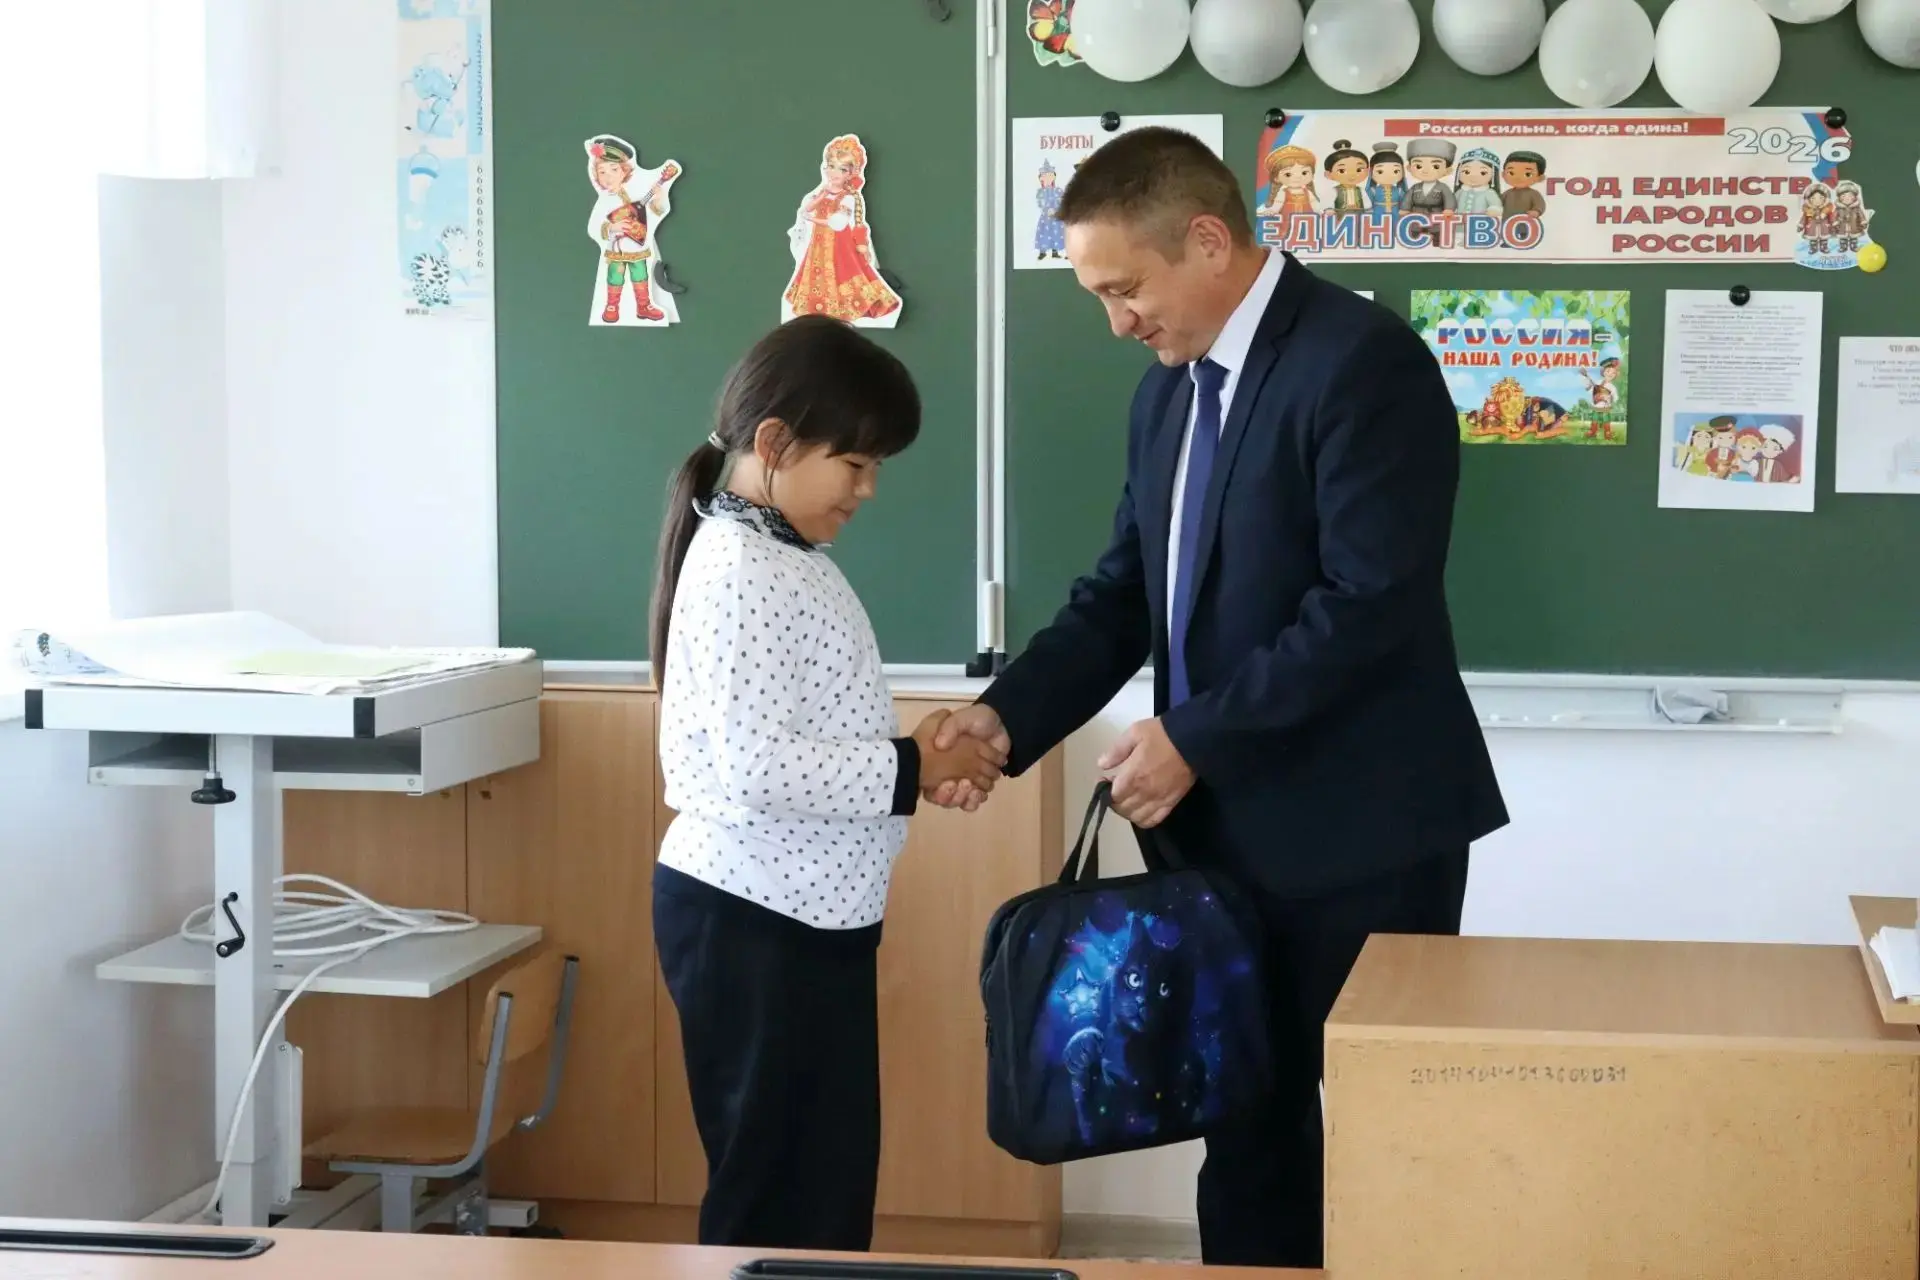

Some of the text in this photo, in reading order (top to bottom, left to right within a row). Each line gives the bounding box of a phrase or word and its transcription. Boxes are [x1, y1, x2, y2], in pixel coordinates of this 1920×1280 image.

[1419, 121, 1689, 135] Россия сильна, когда едина!
[1040, 135, 1094, 149] БУРЯТЫ
[1727, 126, 1852, 162] 2026
[1546, 176, 1836, 198] ГОД ЕДИНСТВ
[1596, 205, 1788, 227] НАРОДОВ
[1256, 212, 1544, 251] ЕДИНСТВО
[1612, 234, 1770, 252] РОССИИ
[1443, 351, 1598, 370] НАША РОДИНА!
